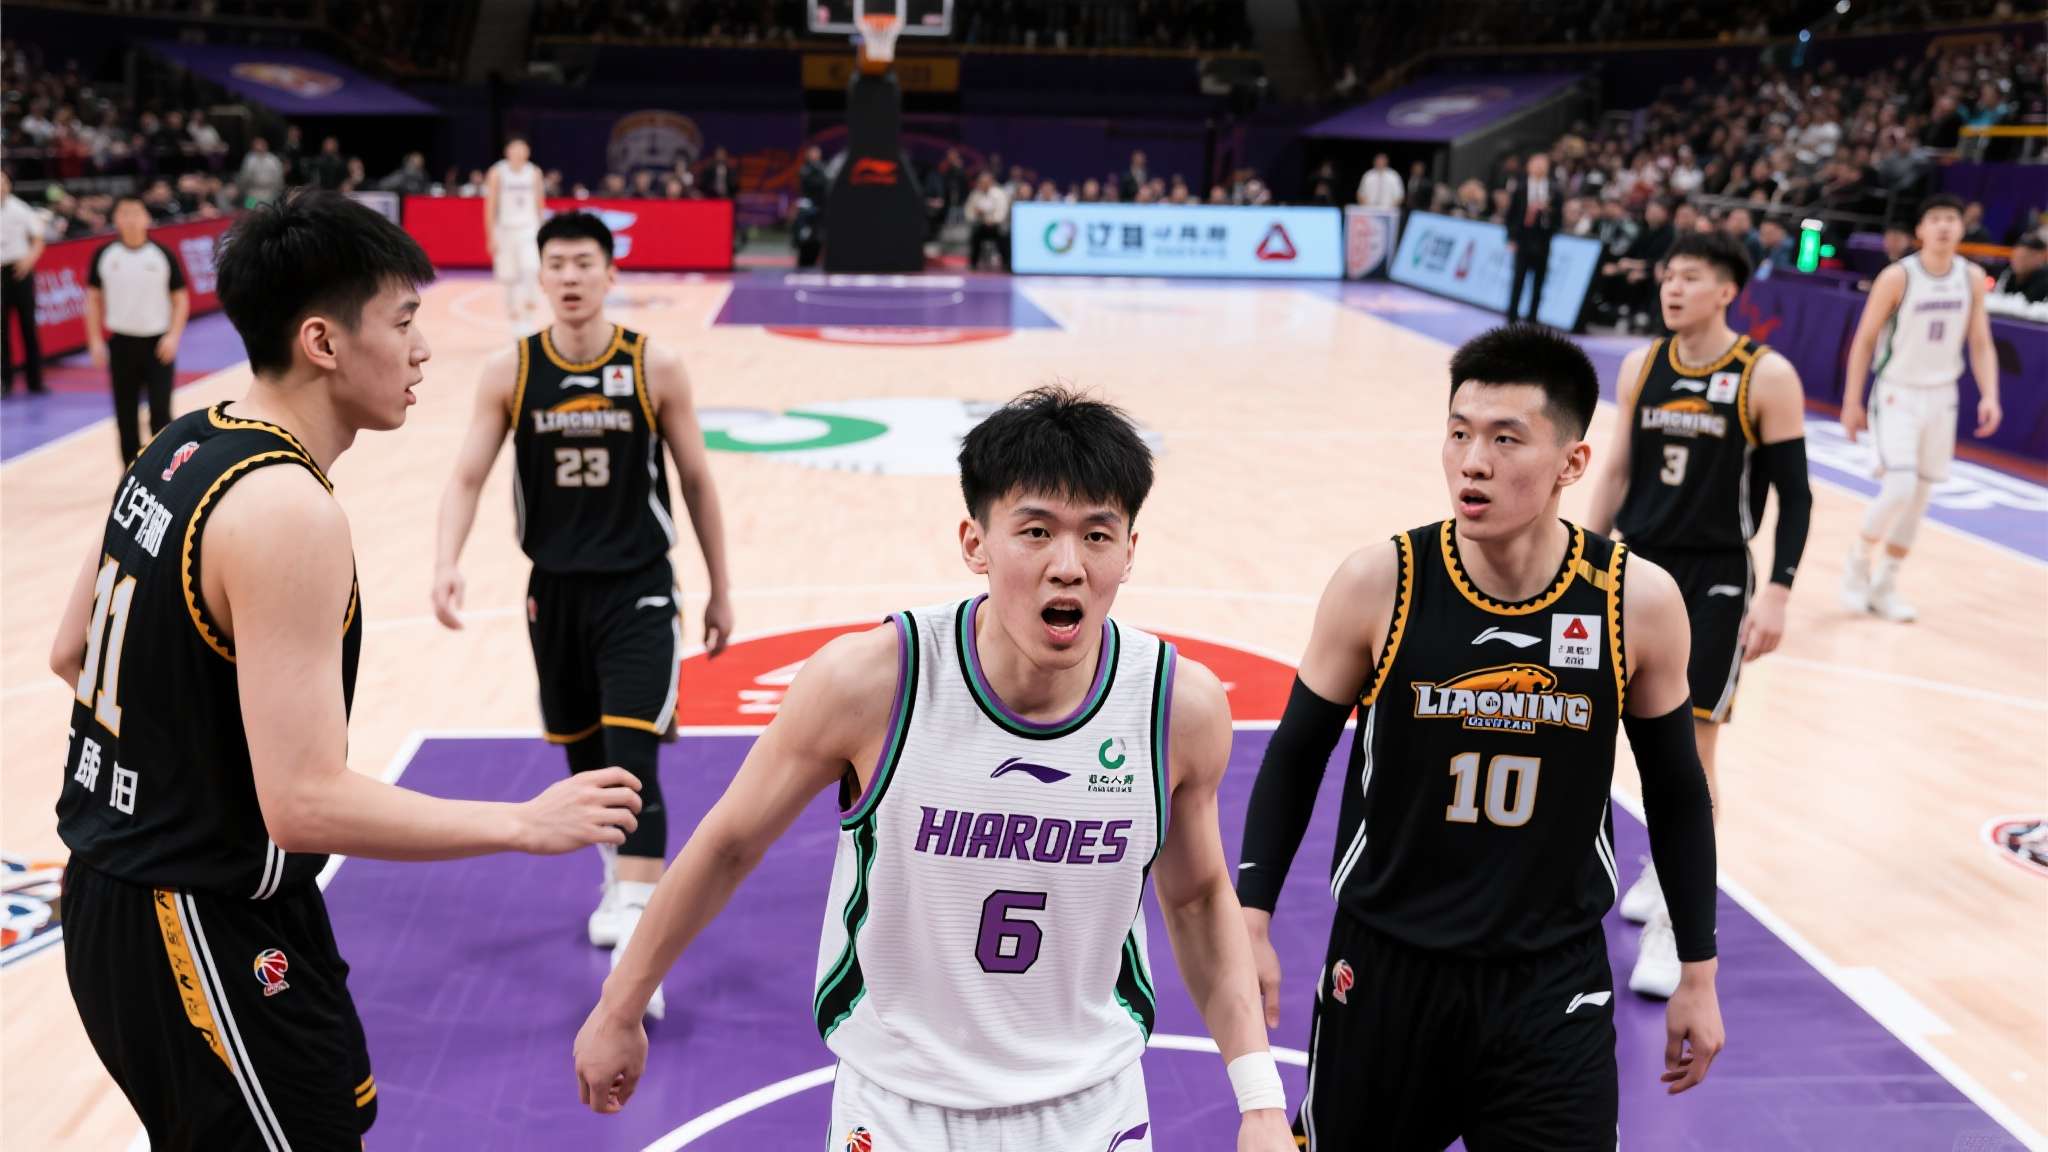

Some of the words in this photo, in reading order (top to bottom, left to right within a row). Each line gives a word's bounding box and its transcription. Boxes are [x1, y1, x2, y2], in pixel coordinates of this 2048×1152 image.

[554, 447, 611, 488] 23
[1660, 444, 1689, 487] 3
[1414, 684, 1591, 729] LIAONING
[1446, 752, 1542, 827] 10
[914, 806, 1133, 865] HIAROES
[975, 889, 1048, 975] 6
